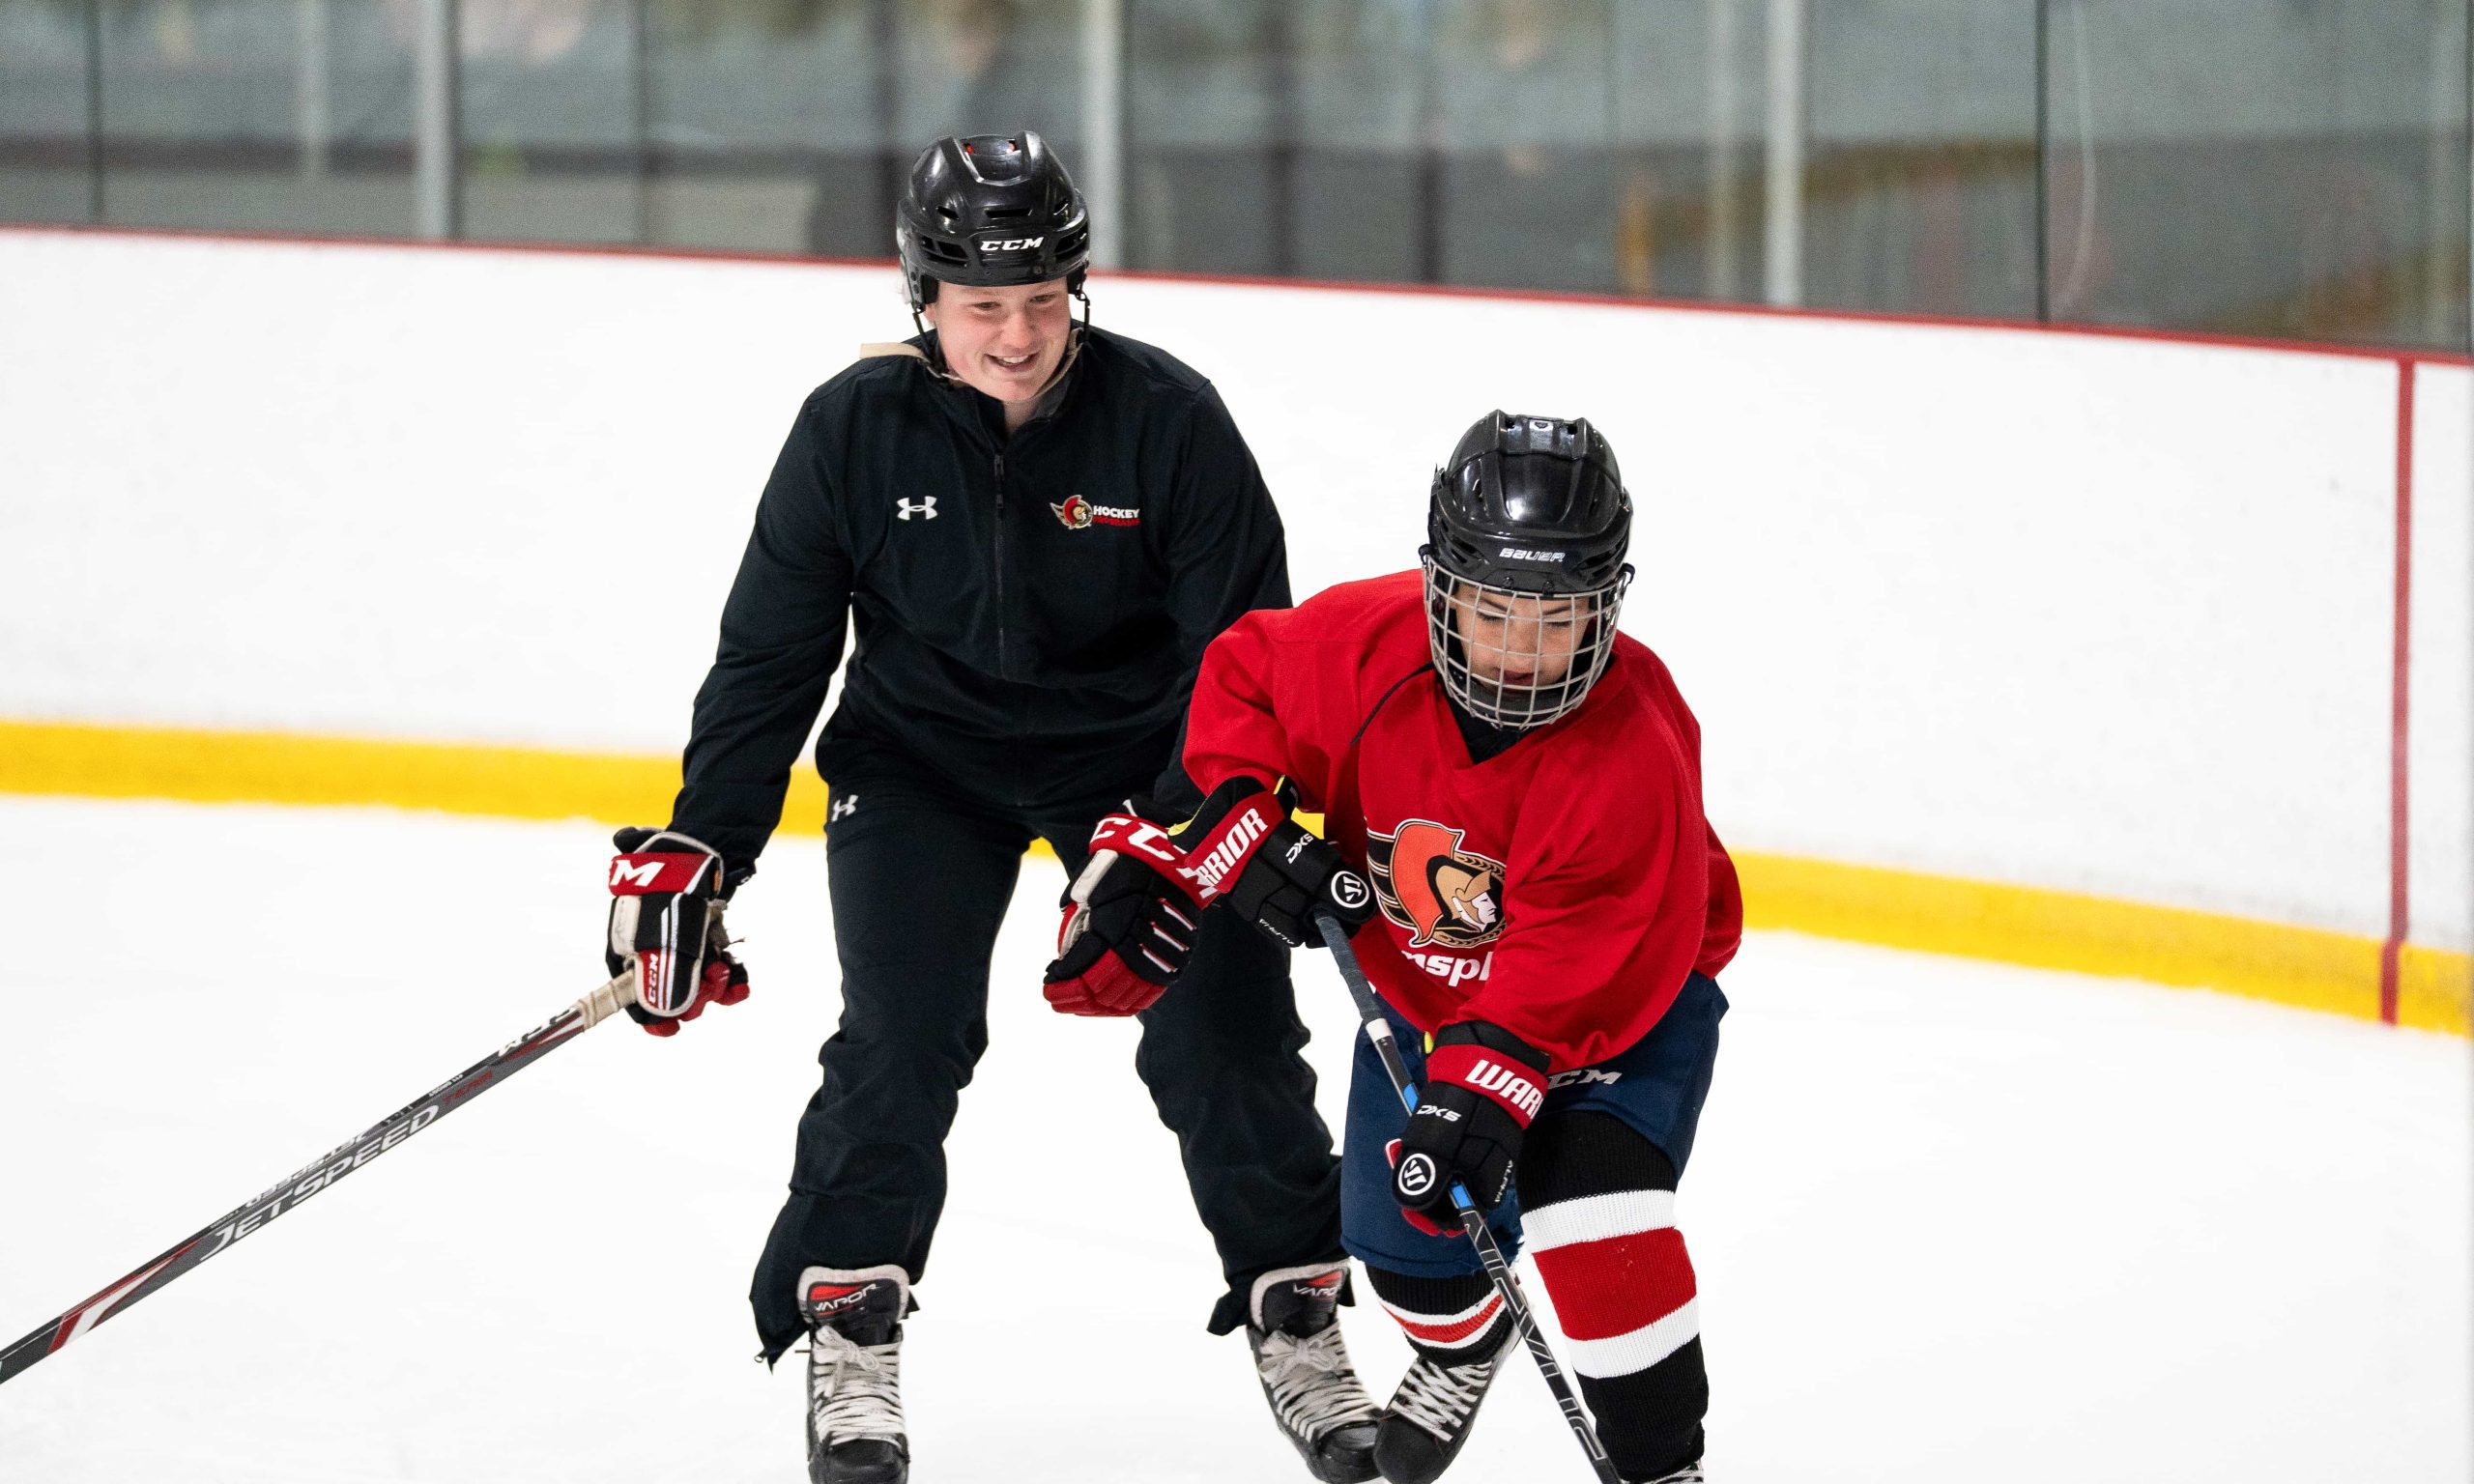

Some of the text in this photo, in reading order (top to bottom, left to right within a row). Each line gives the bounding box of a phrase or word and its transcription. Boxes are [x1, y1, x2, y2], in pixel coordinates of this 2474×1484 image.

[980, 237, 1044, 251] CCM
[1093, 505, 1140, 519] HOCKEY
[1499, 547, 1566, 562] BAUER
[647, 953, 660, 1004] CCM
[1464, 1059, 1546, 1120] WAR
[1547, 1069, 1623, 1090] CM
[199, 1104, 440, 1262] JETSPEED
[815, 1283, 877, 1312] VAPOR
